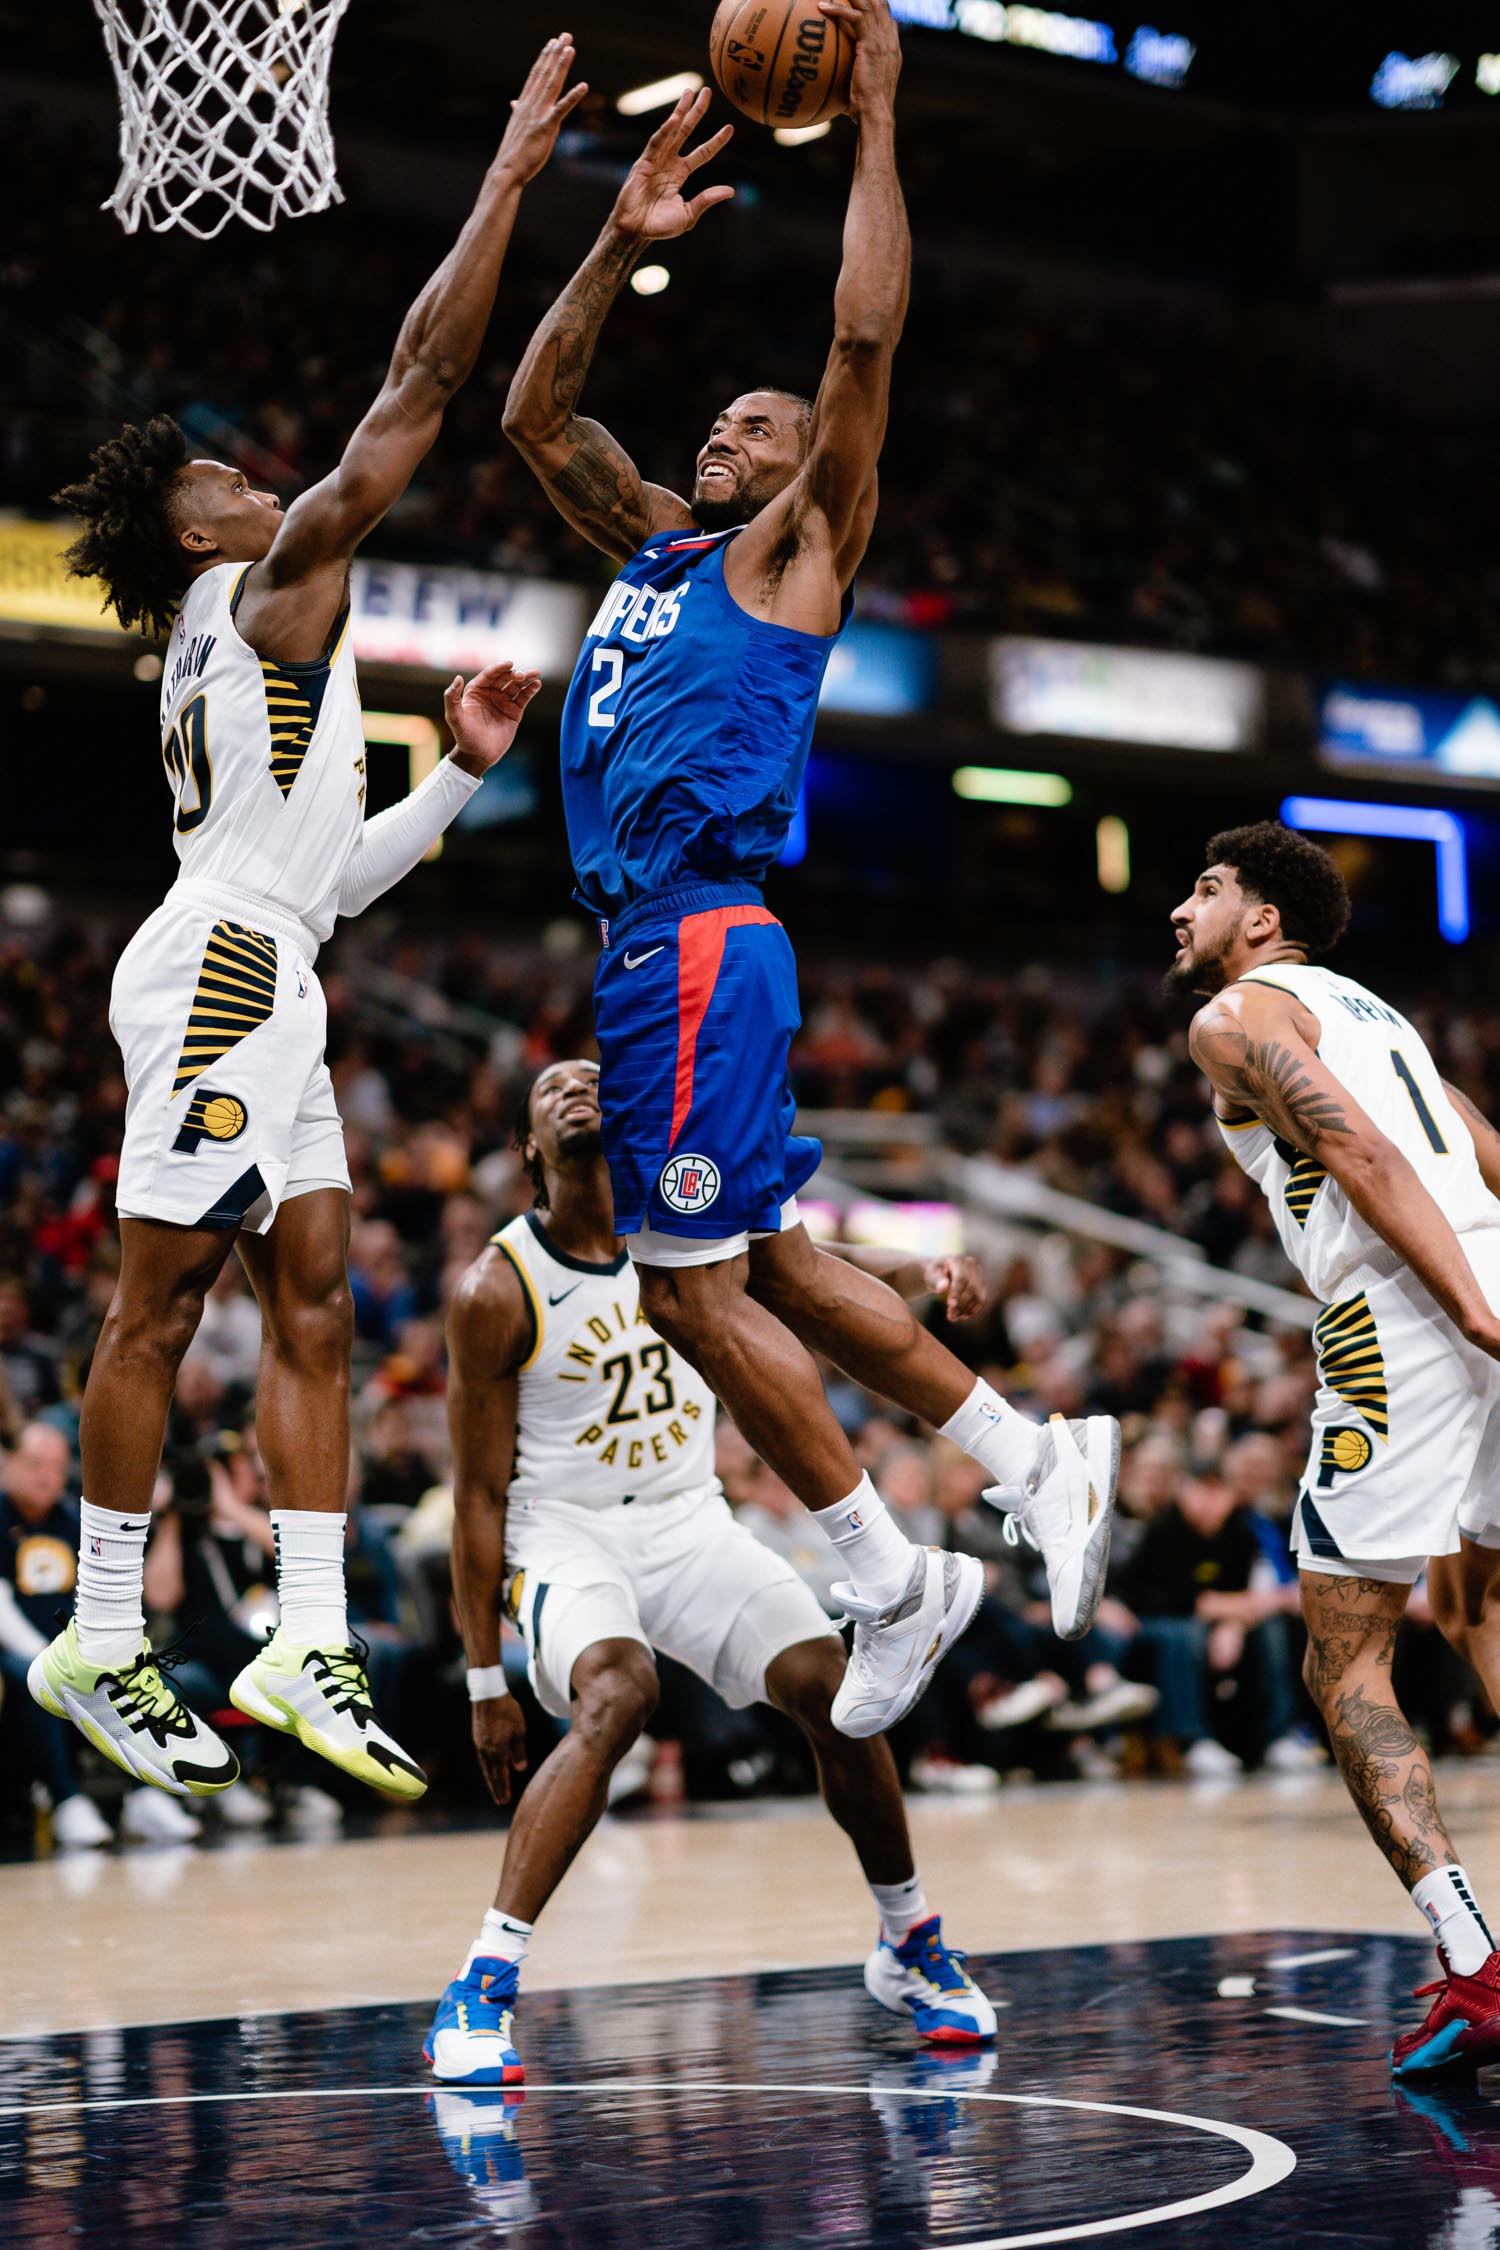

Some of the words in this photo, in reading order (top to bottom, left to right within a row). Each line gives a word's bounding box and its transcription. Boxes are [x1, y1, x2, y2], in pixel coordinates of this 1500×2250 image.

[775, 17, 827, 118] Wilson
[588, 648, 624, 727] 2
[1390, 1048, 1449, 1154] 1
[557, 1301, 650, 1382] INDIA
[602, 1341, 675, 1426] 23
[574, 1399, 702, 1470] PACERS
